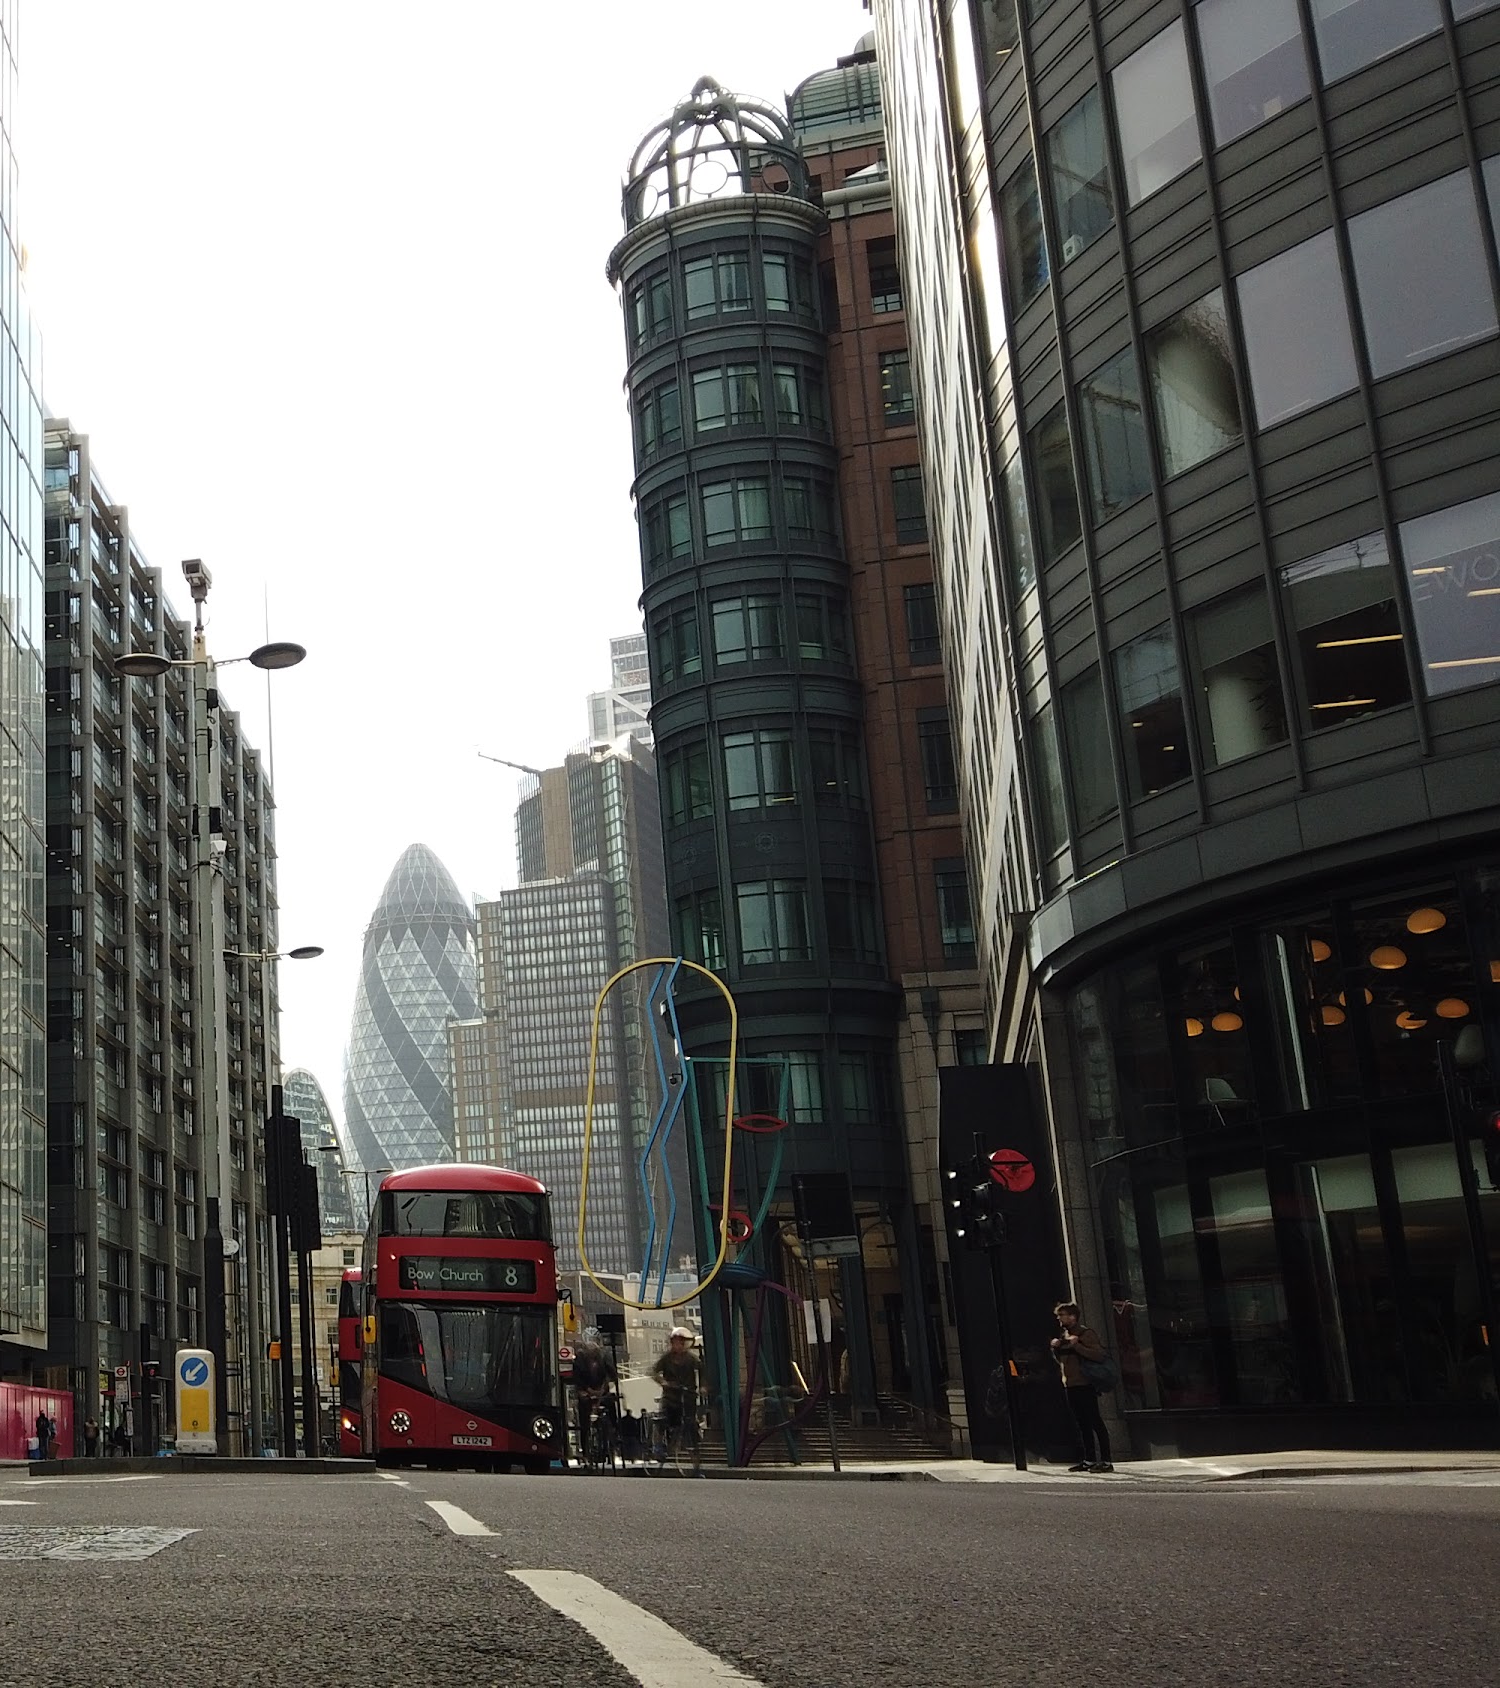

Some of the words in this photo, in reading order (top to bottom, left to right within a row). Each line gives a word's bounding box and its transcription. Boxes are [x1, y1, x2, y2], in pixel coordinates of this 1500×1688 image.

[407, 1266, 435, 1280] Bow
[440, 1267, 484, 1282] Church
[505, 1266, 517, 1286] 8
